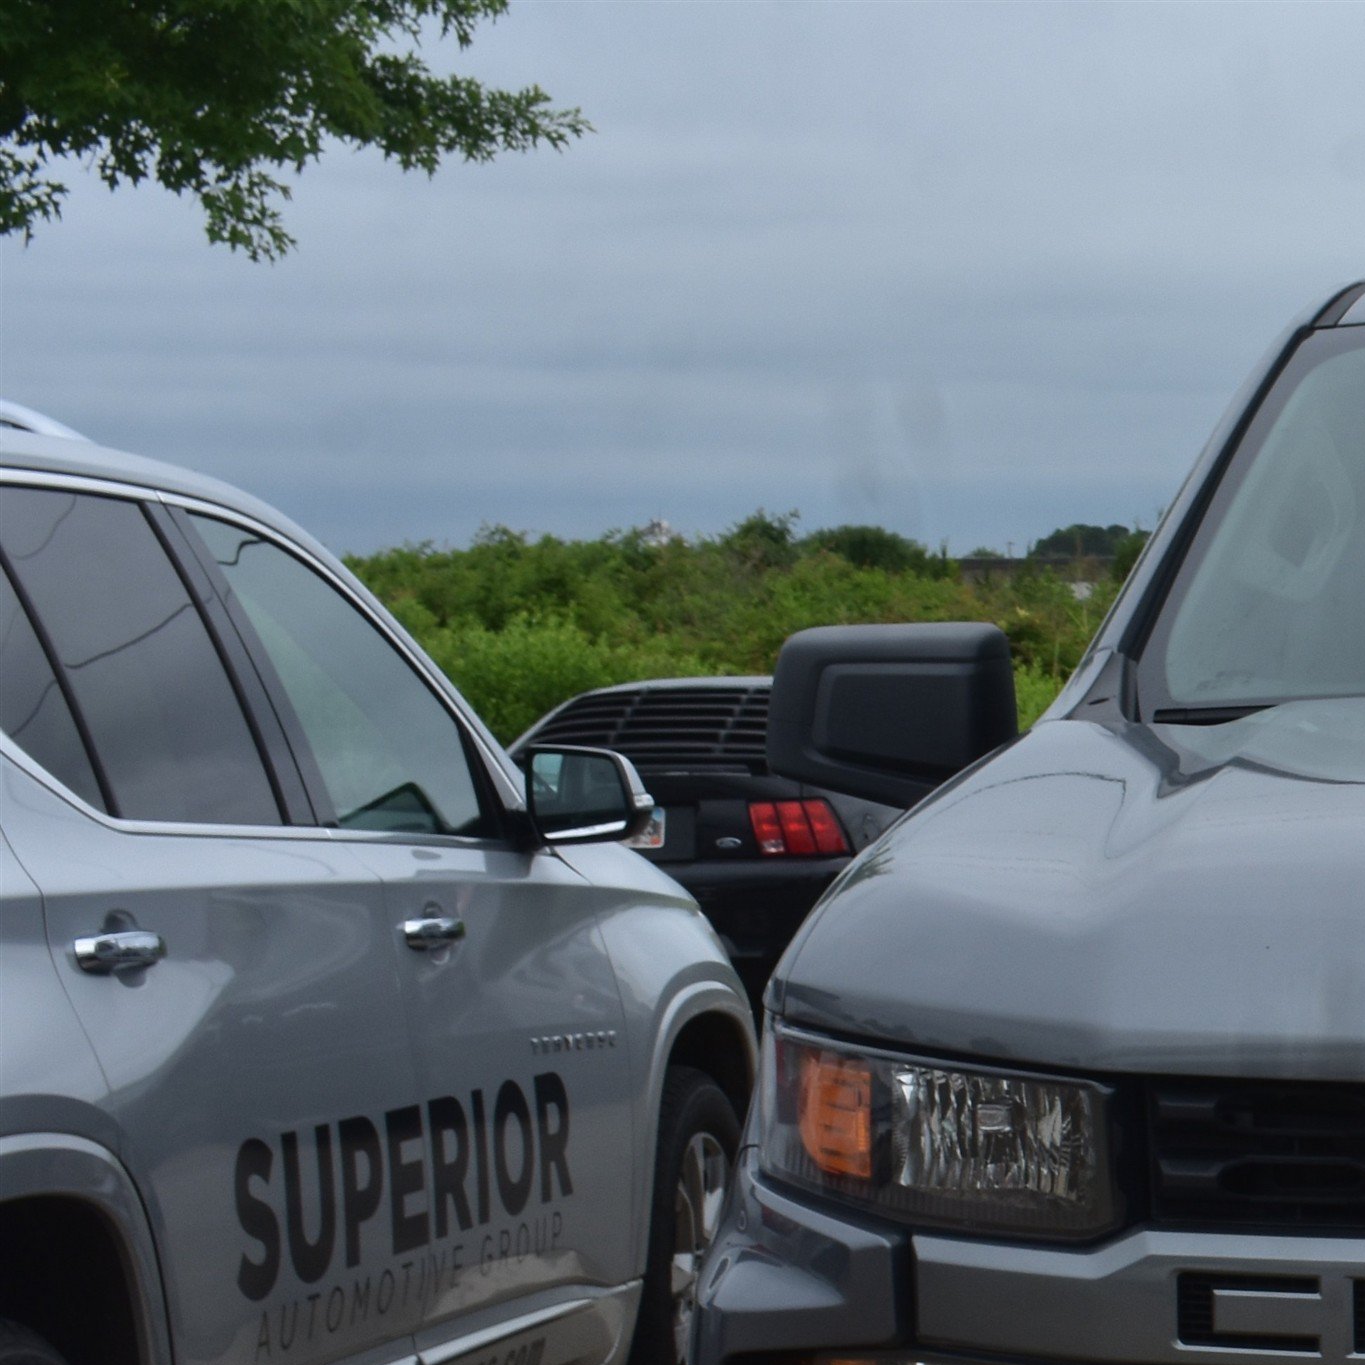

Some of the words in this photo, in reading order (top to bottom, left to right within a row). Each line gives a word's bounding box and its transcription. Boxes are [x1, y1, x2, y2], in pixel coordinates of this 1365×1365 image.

[234, 1071, 574, 1302] SUPERIOR
[255, 1244, 464, 1363] AUTOMOTIVE
[480, 1211, 563, 1278] GROUP
